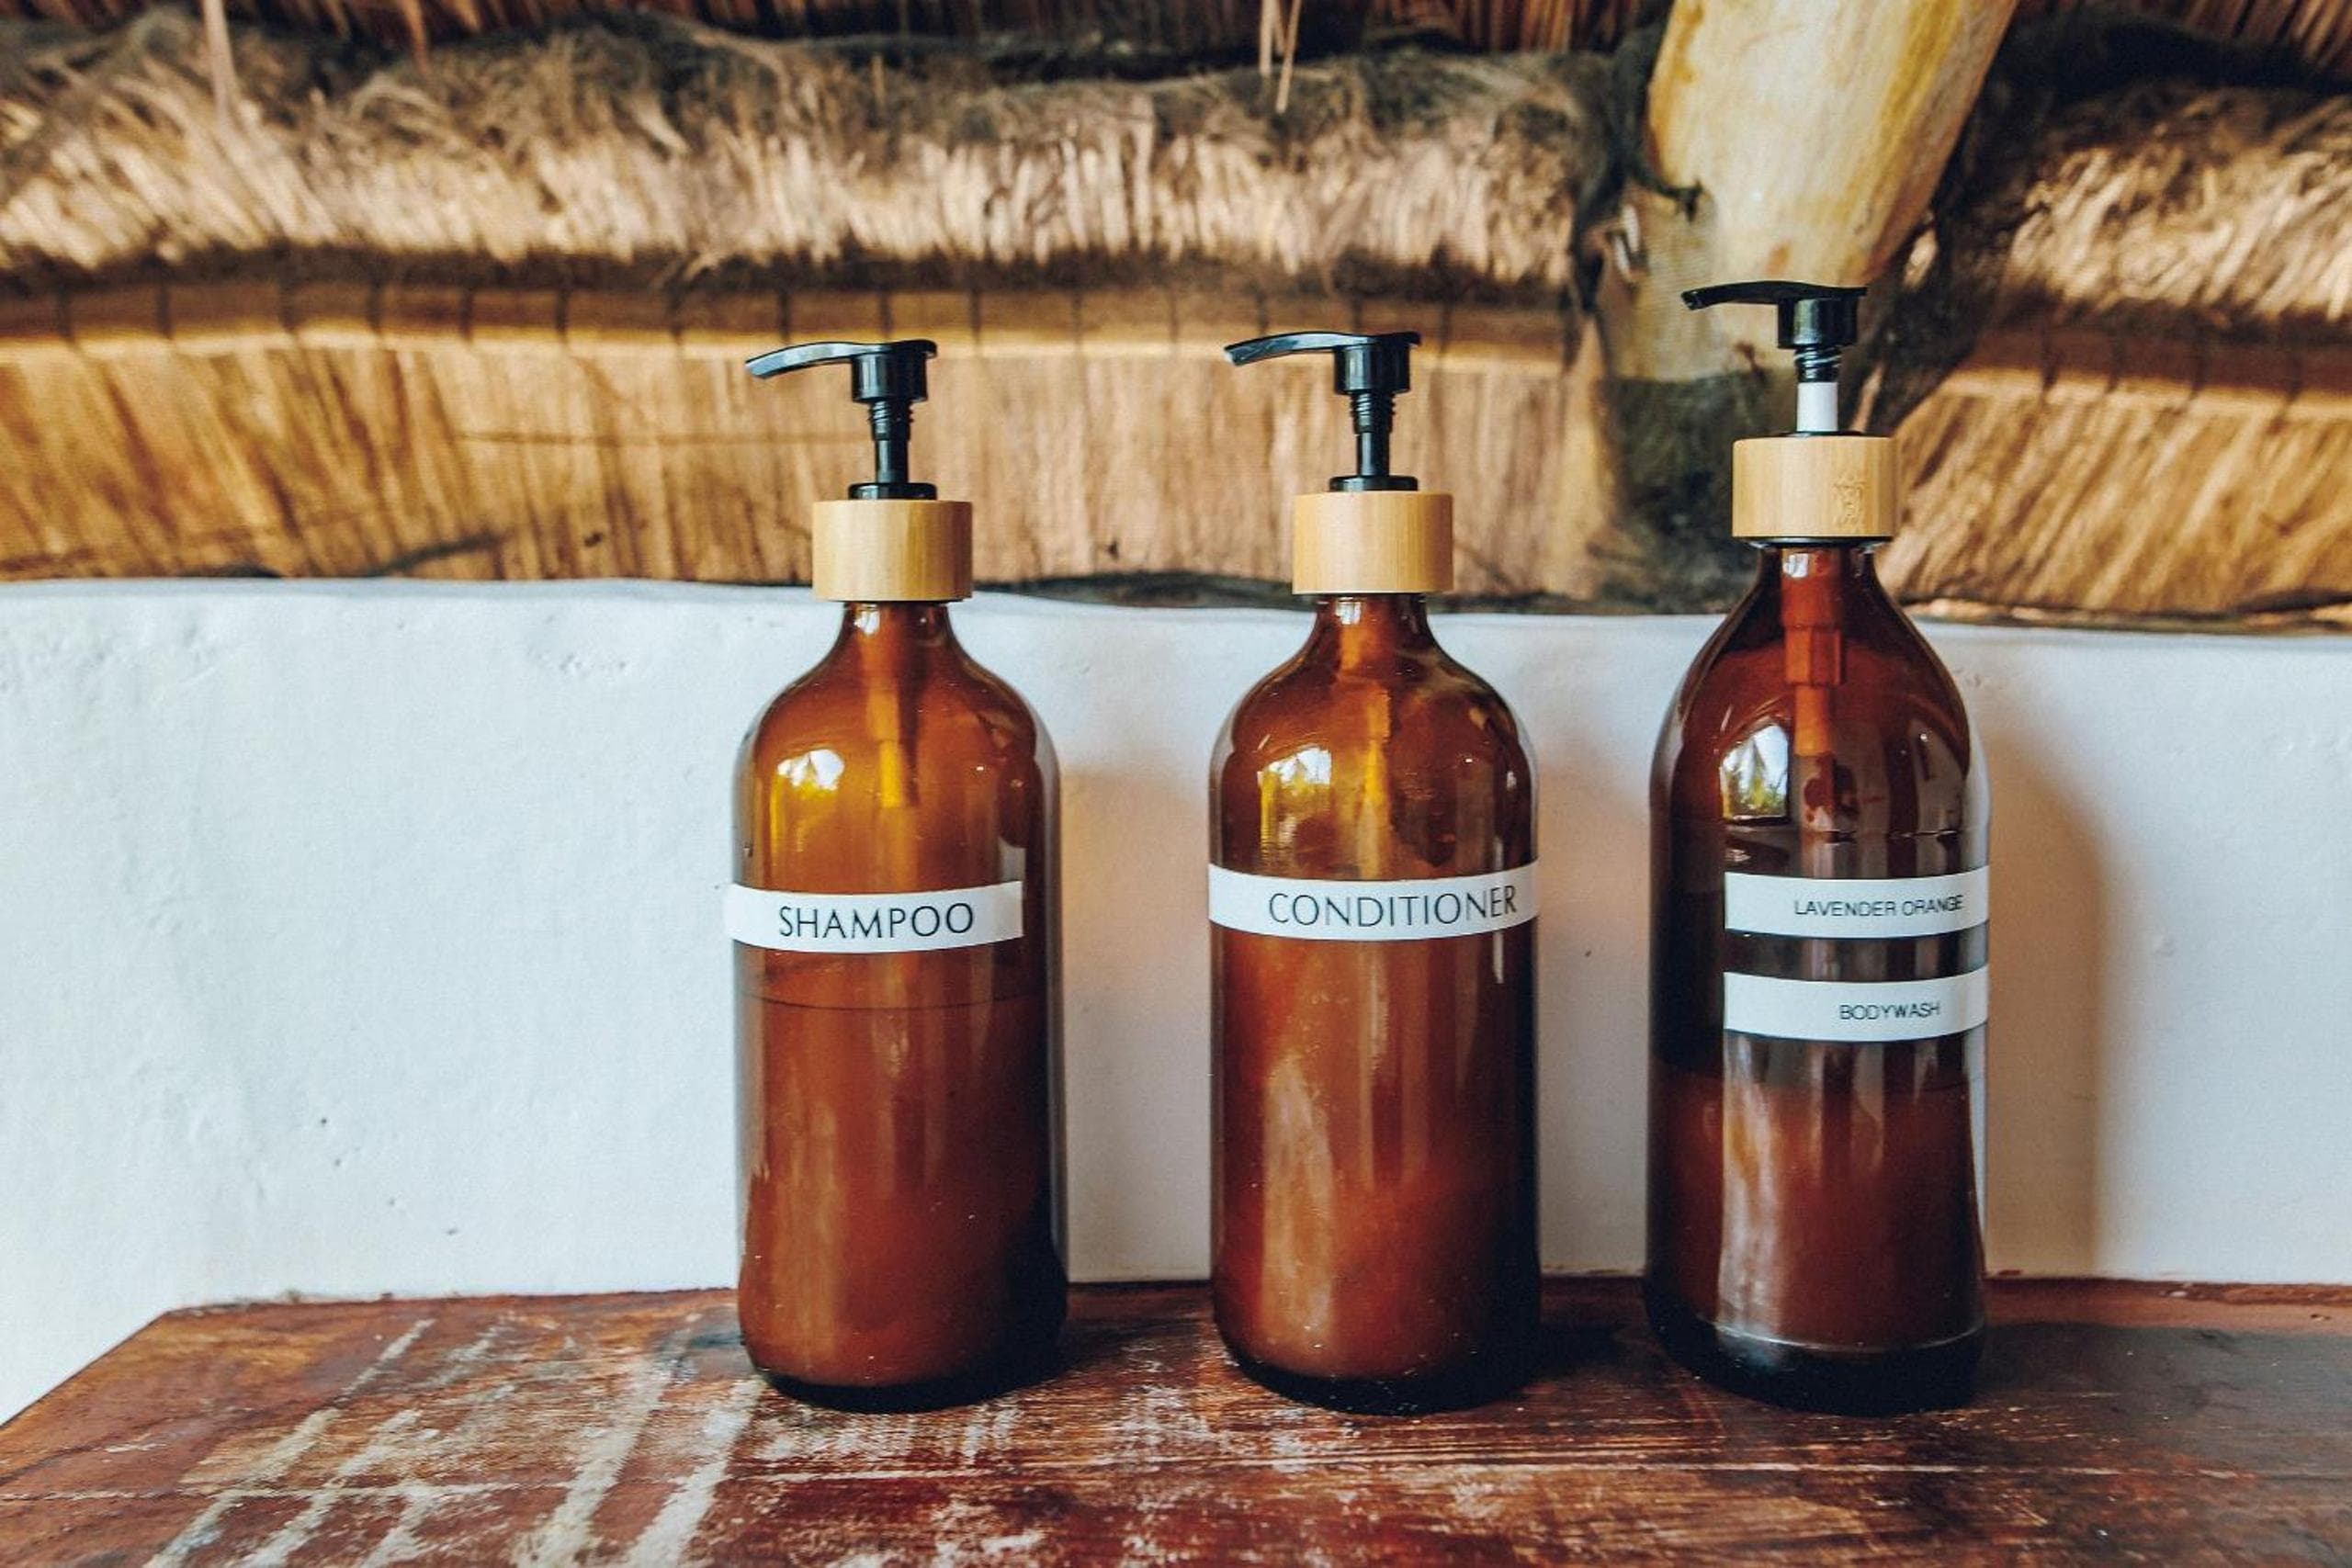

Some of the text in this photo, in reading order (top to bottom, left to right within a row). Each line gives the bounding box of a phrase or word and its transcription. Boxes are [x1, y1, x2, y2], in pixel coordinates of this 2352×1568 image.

[779, 902, 974, 939] SHAMPOO
[1268, 886, 1517, 928] CONDITIONER
[1794, 895, 1964, 917] LAVENDER ORANGE
[1839, 1002, 1940, 1021] BODYWASH
